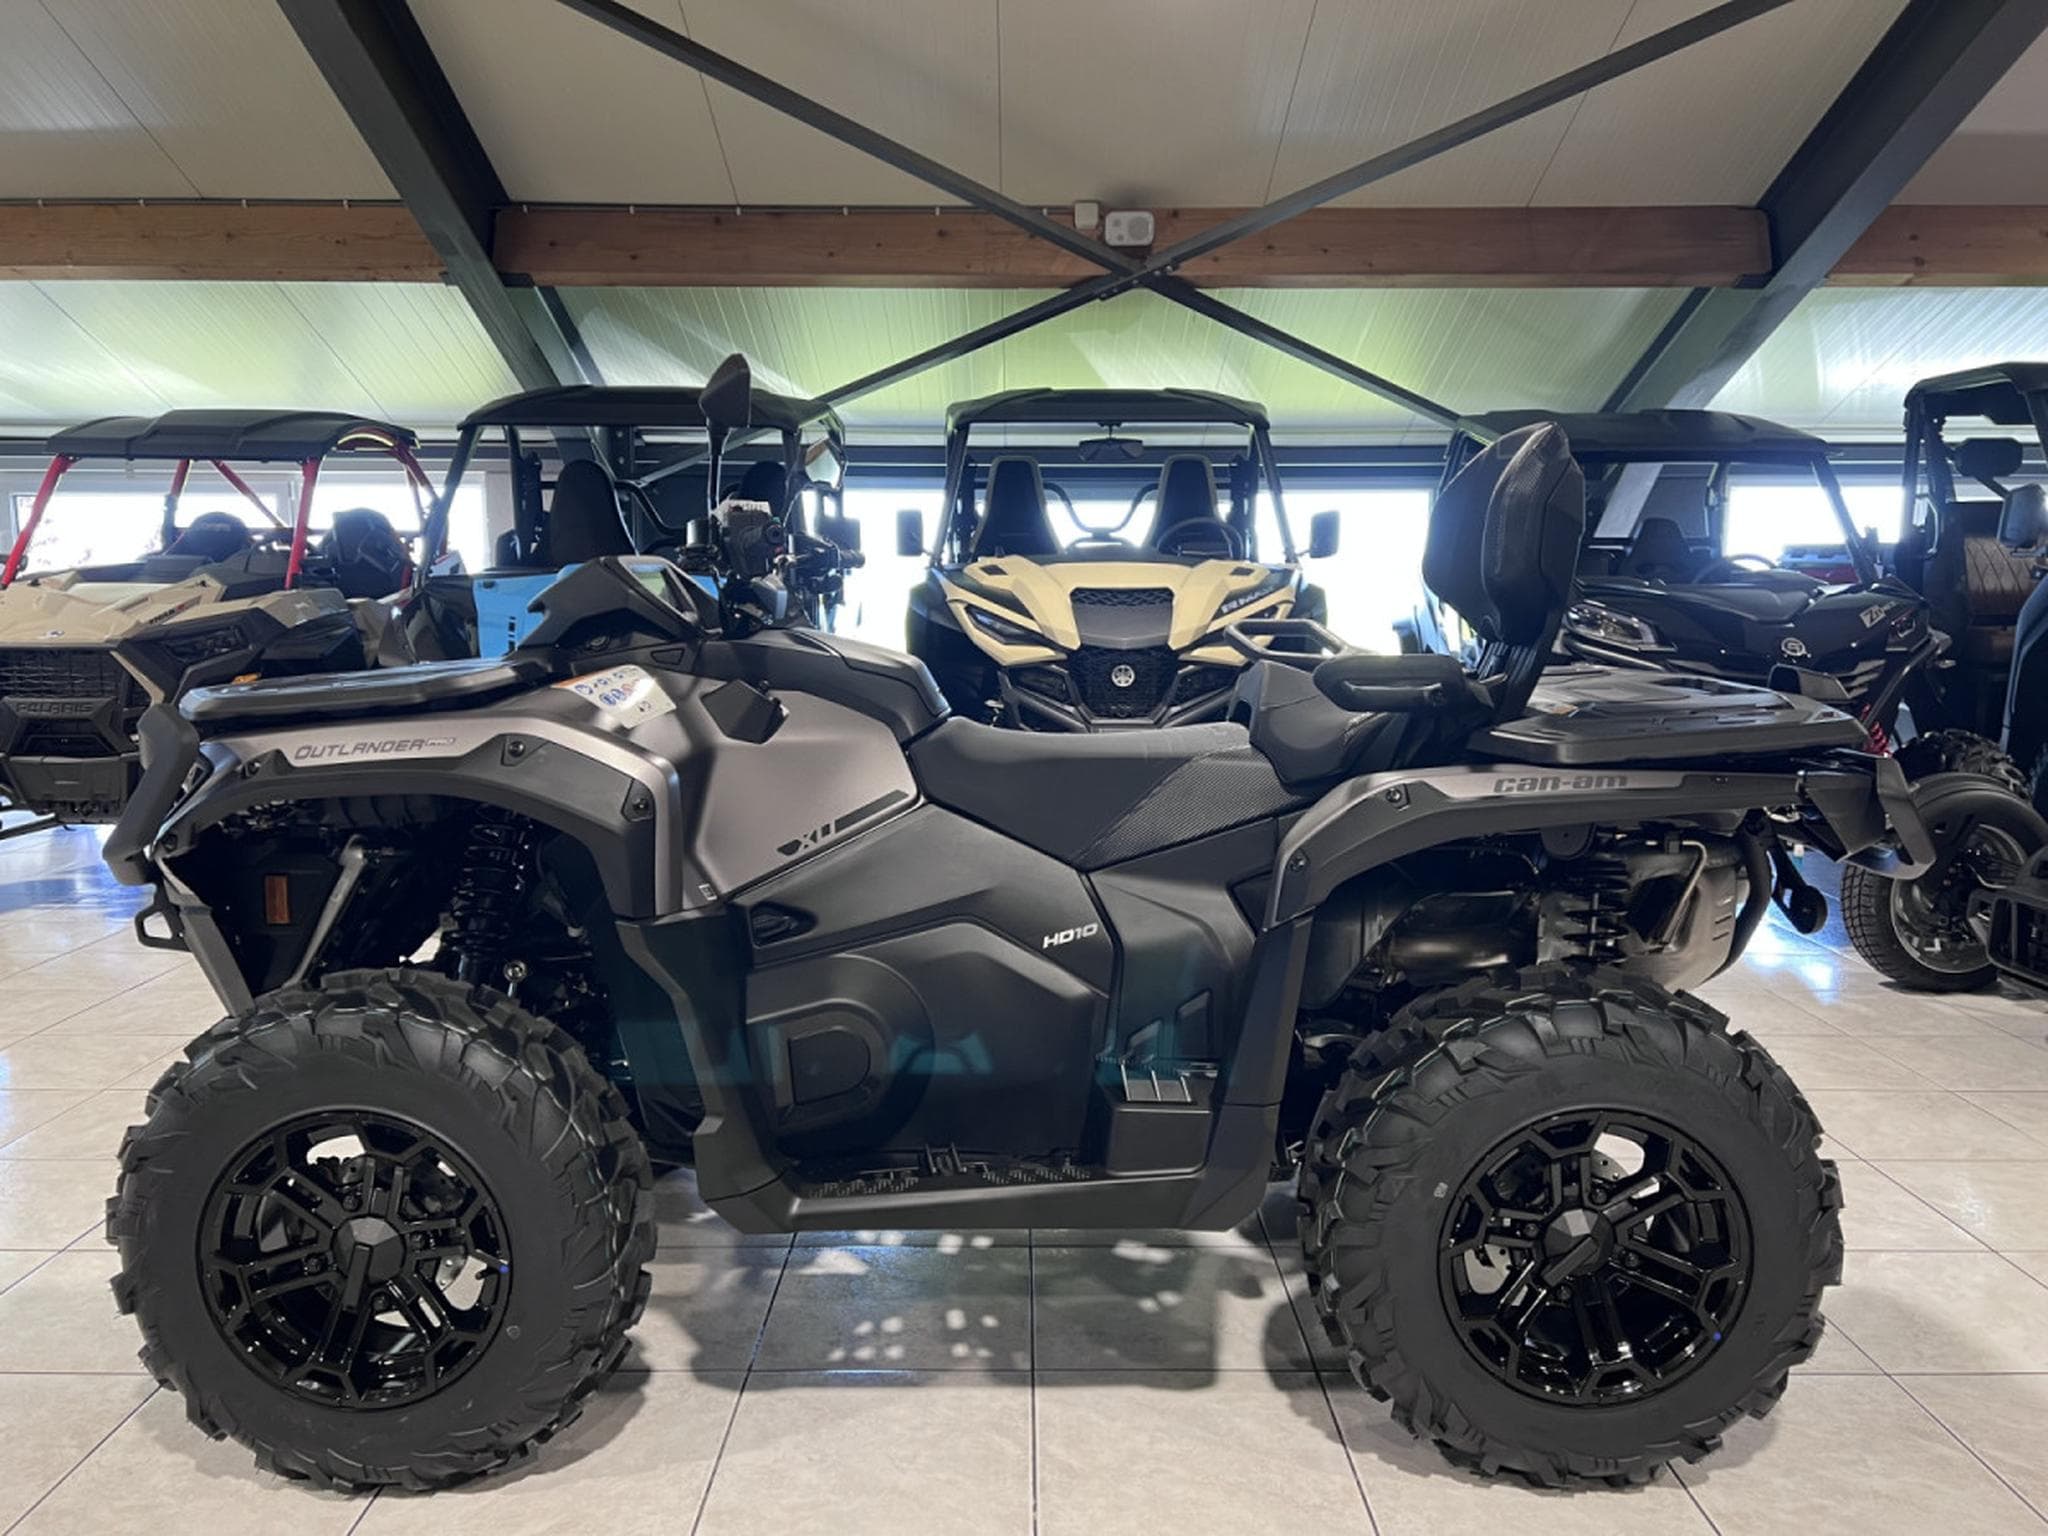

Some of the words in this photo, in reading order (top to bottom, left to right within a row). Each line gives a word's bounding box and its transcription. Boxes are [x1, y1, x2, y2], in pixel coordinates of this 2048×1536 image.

[16, 702, 93, 713] POLARIS
[294, 739, 425, 760] OUTLANDER
[1493, 774, 1628, 793] can-am
[1043, 922, 1099, 949] HD10
